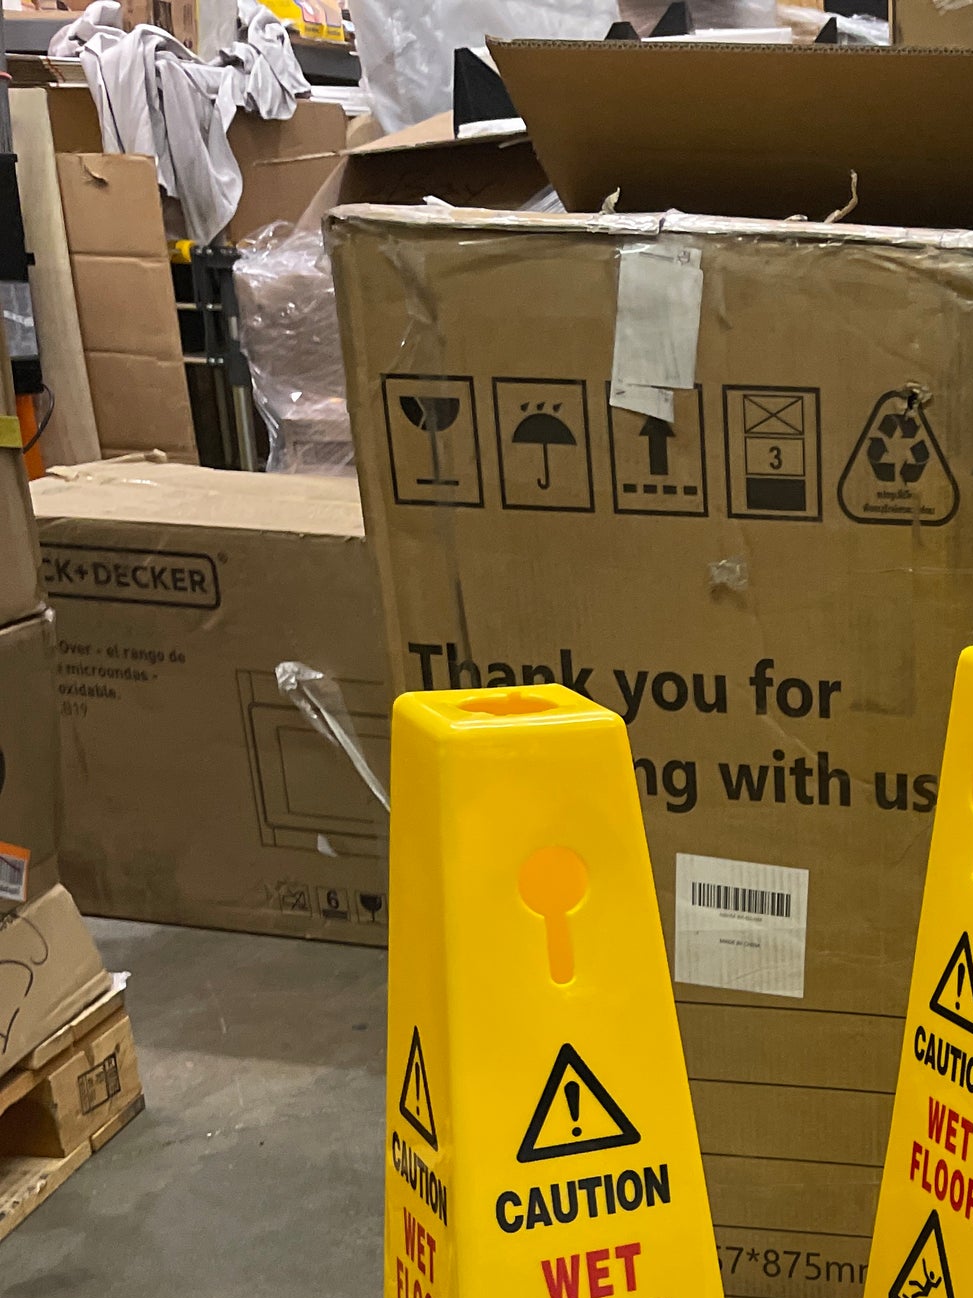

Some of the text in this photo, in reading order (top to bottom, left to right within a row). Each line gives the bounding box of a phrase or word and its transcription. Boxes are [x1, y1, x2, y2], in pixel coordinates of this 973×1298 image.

[769, 446, 782, 470] 3
[409, 641, 841, 725] Thank you for
[717, 750, 851, 807] with
[874, 774, 938, 813] us
[327, 890, 339, 909] 6
[928, 1096, 973, 1162] WET
[392, 1131, 447, 1227] CAUTION
[495, 1164, 671, 1233] CAUTION
[403, 1207, 436, 1284] WET
